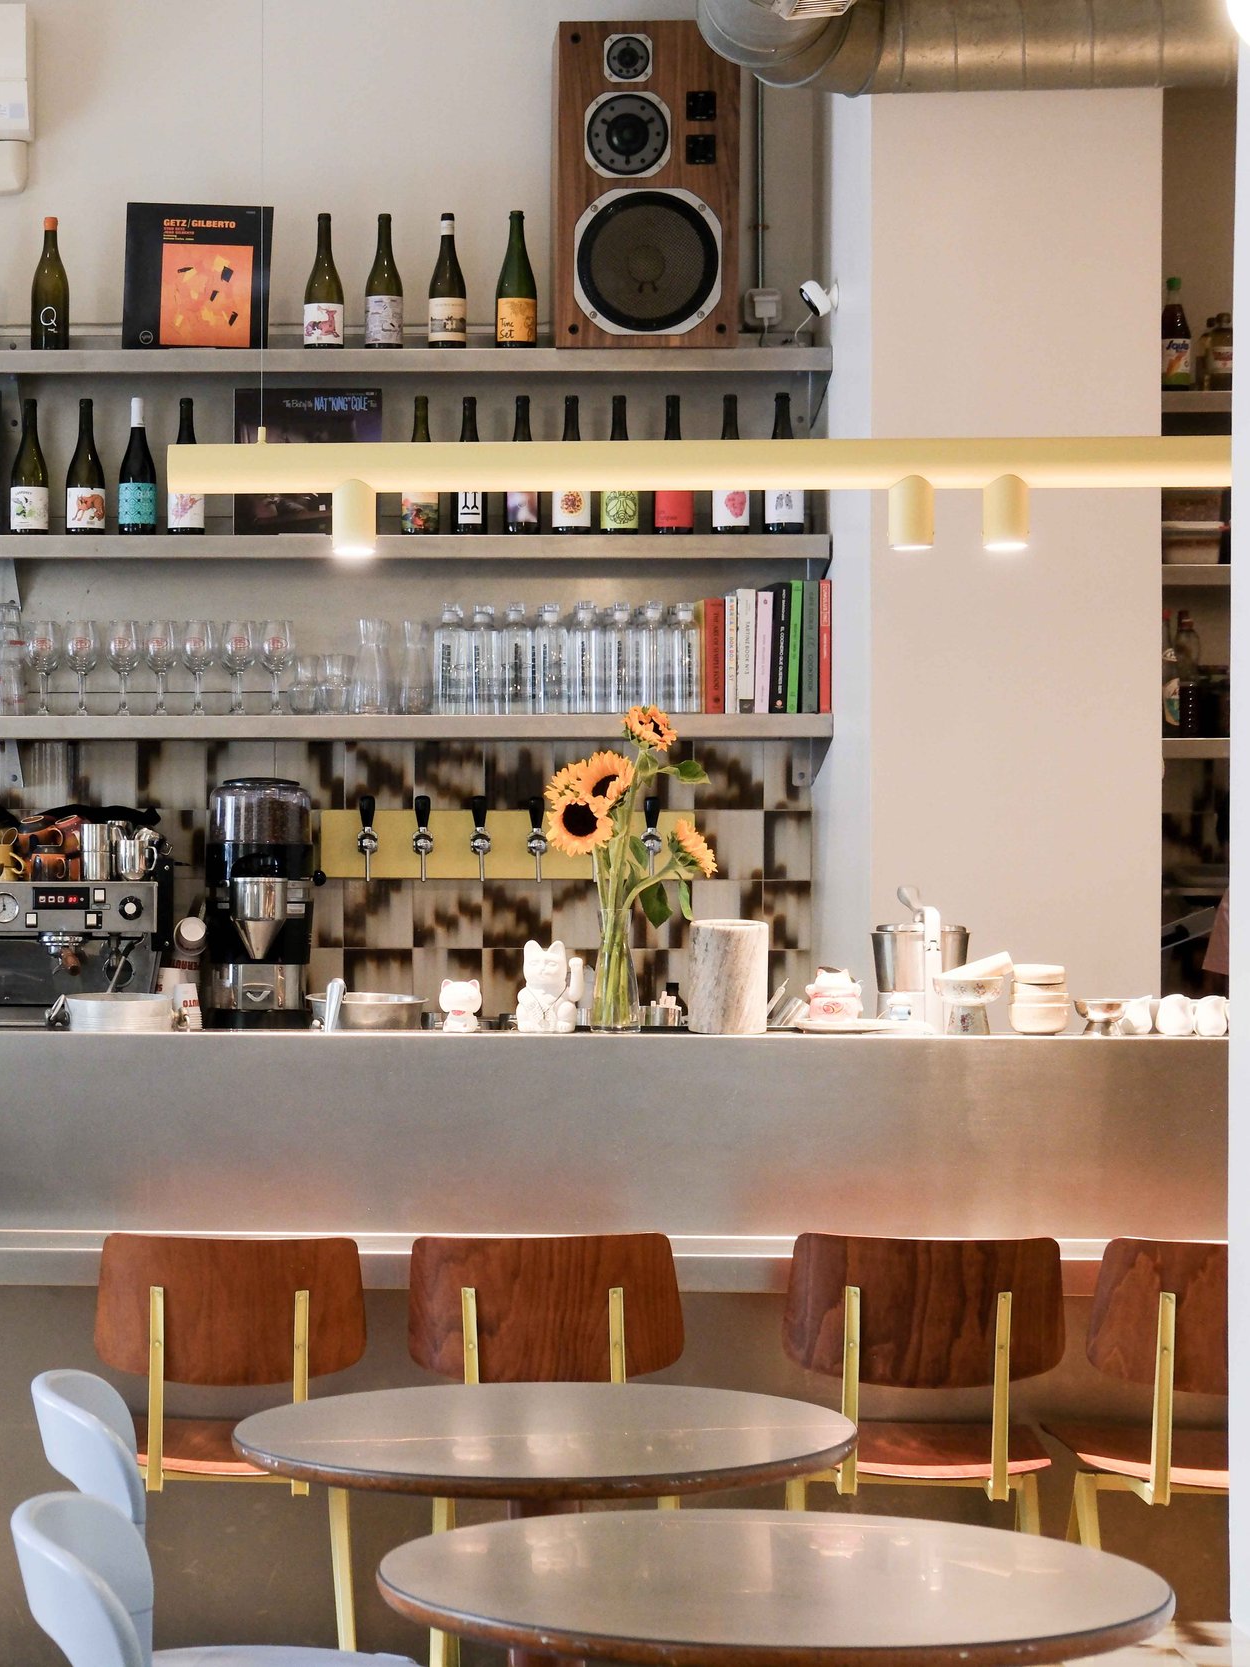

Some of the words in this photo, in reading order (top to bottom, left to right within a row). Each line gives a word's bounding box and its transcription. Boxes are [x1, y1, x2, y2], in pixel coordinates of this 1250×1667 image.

[163, 218, 236, 228] GETZ/GILBERTO
[314, 396, 327, 411] NAT
[351, 396, 368, 411] COLE
